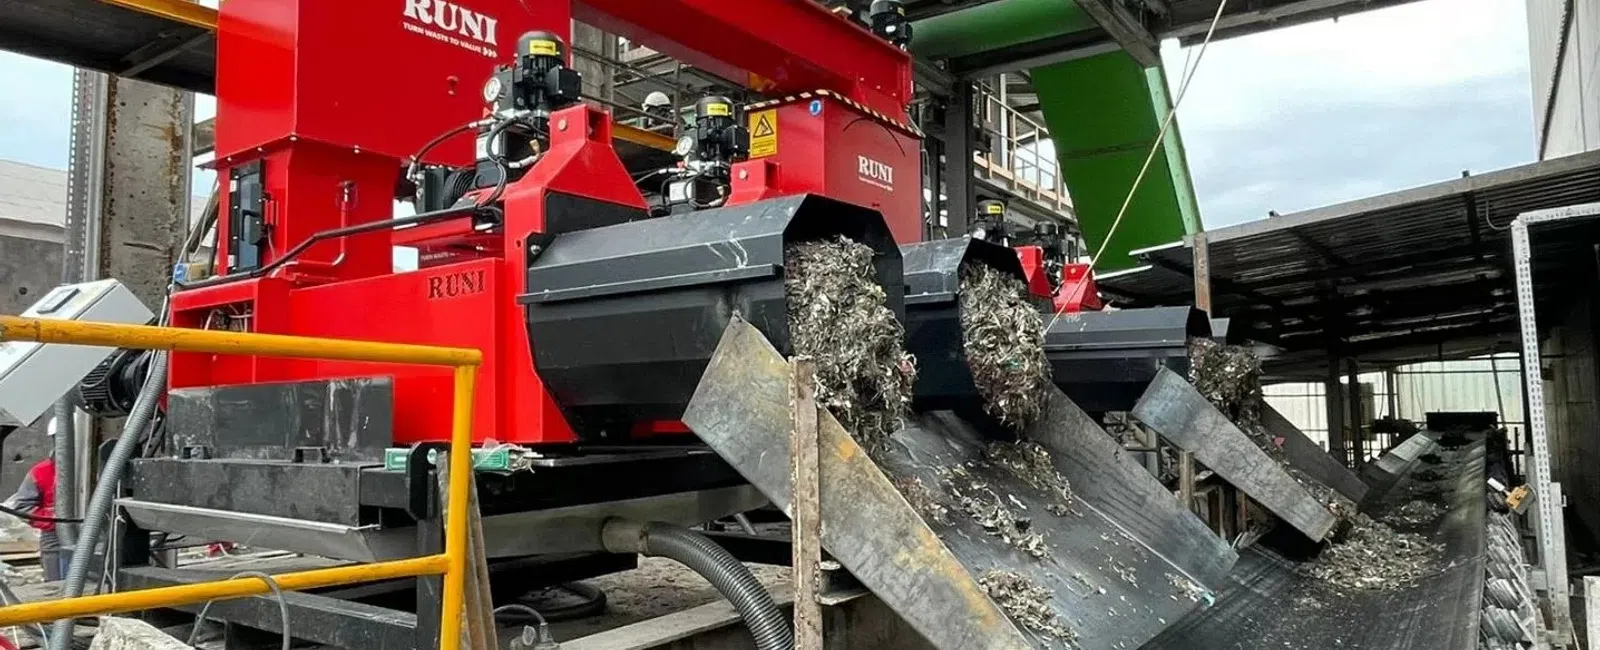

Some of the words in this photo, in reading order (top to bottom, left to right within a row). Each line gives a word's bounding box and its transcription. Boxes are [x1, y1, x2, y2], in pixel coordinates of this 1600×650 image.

[403, 0, 498, 46] RUNI
[403, 22, 424, 34] TURN
[425, 29, 449, 43] WASTE
[449, 37, 460, 46] TO
[460, 41, 482, 54] VALUE
[858, 155, 893, 184] RUNI
[428, 270, 485, 299] RUNI
